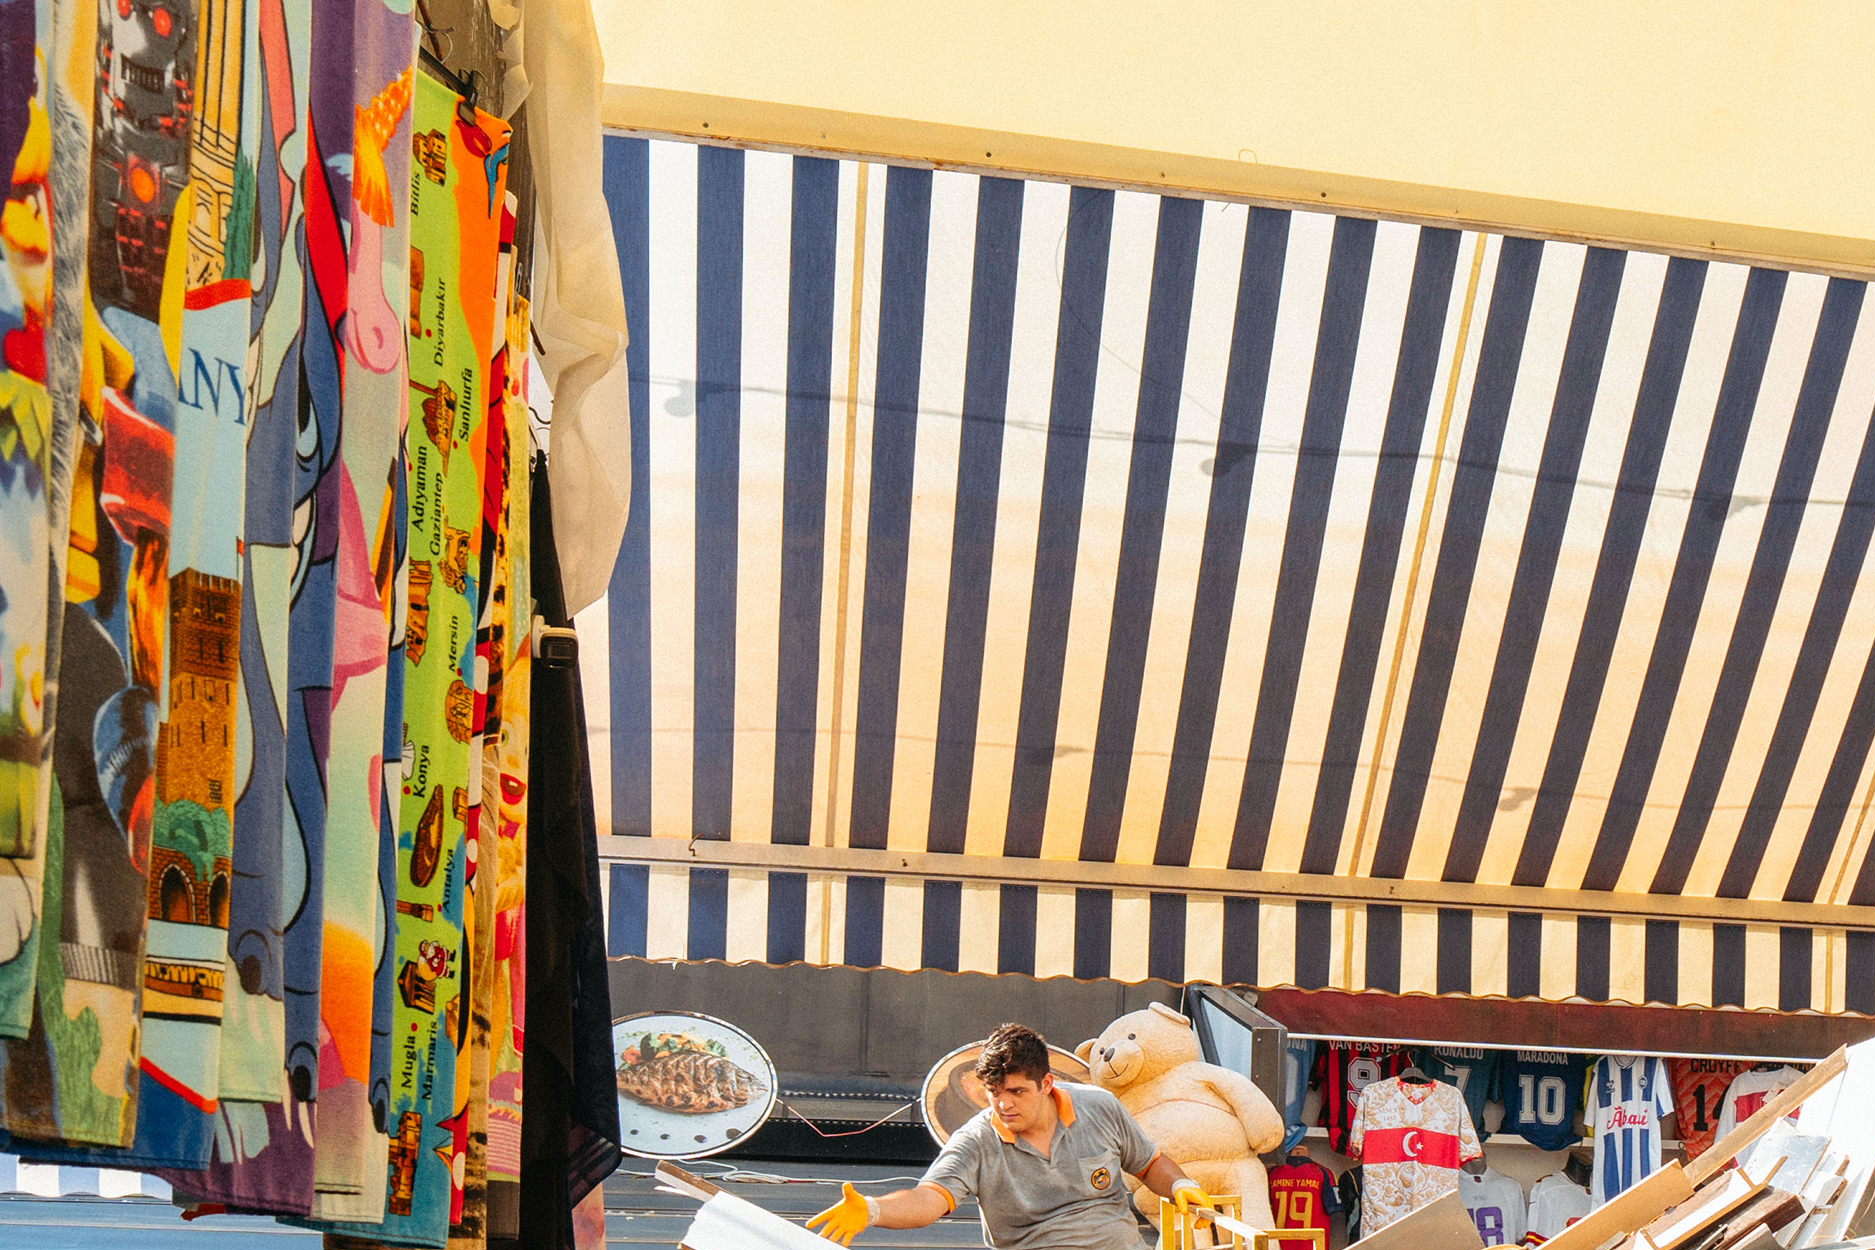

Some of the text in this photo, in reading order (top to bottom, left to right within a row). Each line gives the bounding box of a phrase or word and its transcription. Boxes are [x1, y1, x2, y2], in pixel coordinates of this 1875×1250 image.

[410, 171, 421, 217] Bitlis
[429, 472, 444, 557] Gaziantep
[448, 614, 459, 673] Mersin
[413, 744, 431, 799] Konya
[442, 848, 454, 914] Antalya
[421, 1020, 438, 1101] Marmaris
[1329, 1039, 1352, 1051] VAN
[1517, 1050, 1569, 1066] MARADONA
[1690, 1057, 1743, 1075] CRUYFF
[1518, 1073, 1566, 1126] 10
[1296, 1178, 1320, 1190] YAMAL
[1274, 1190, 1314, 1229] 19
